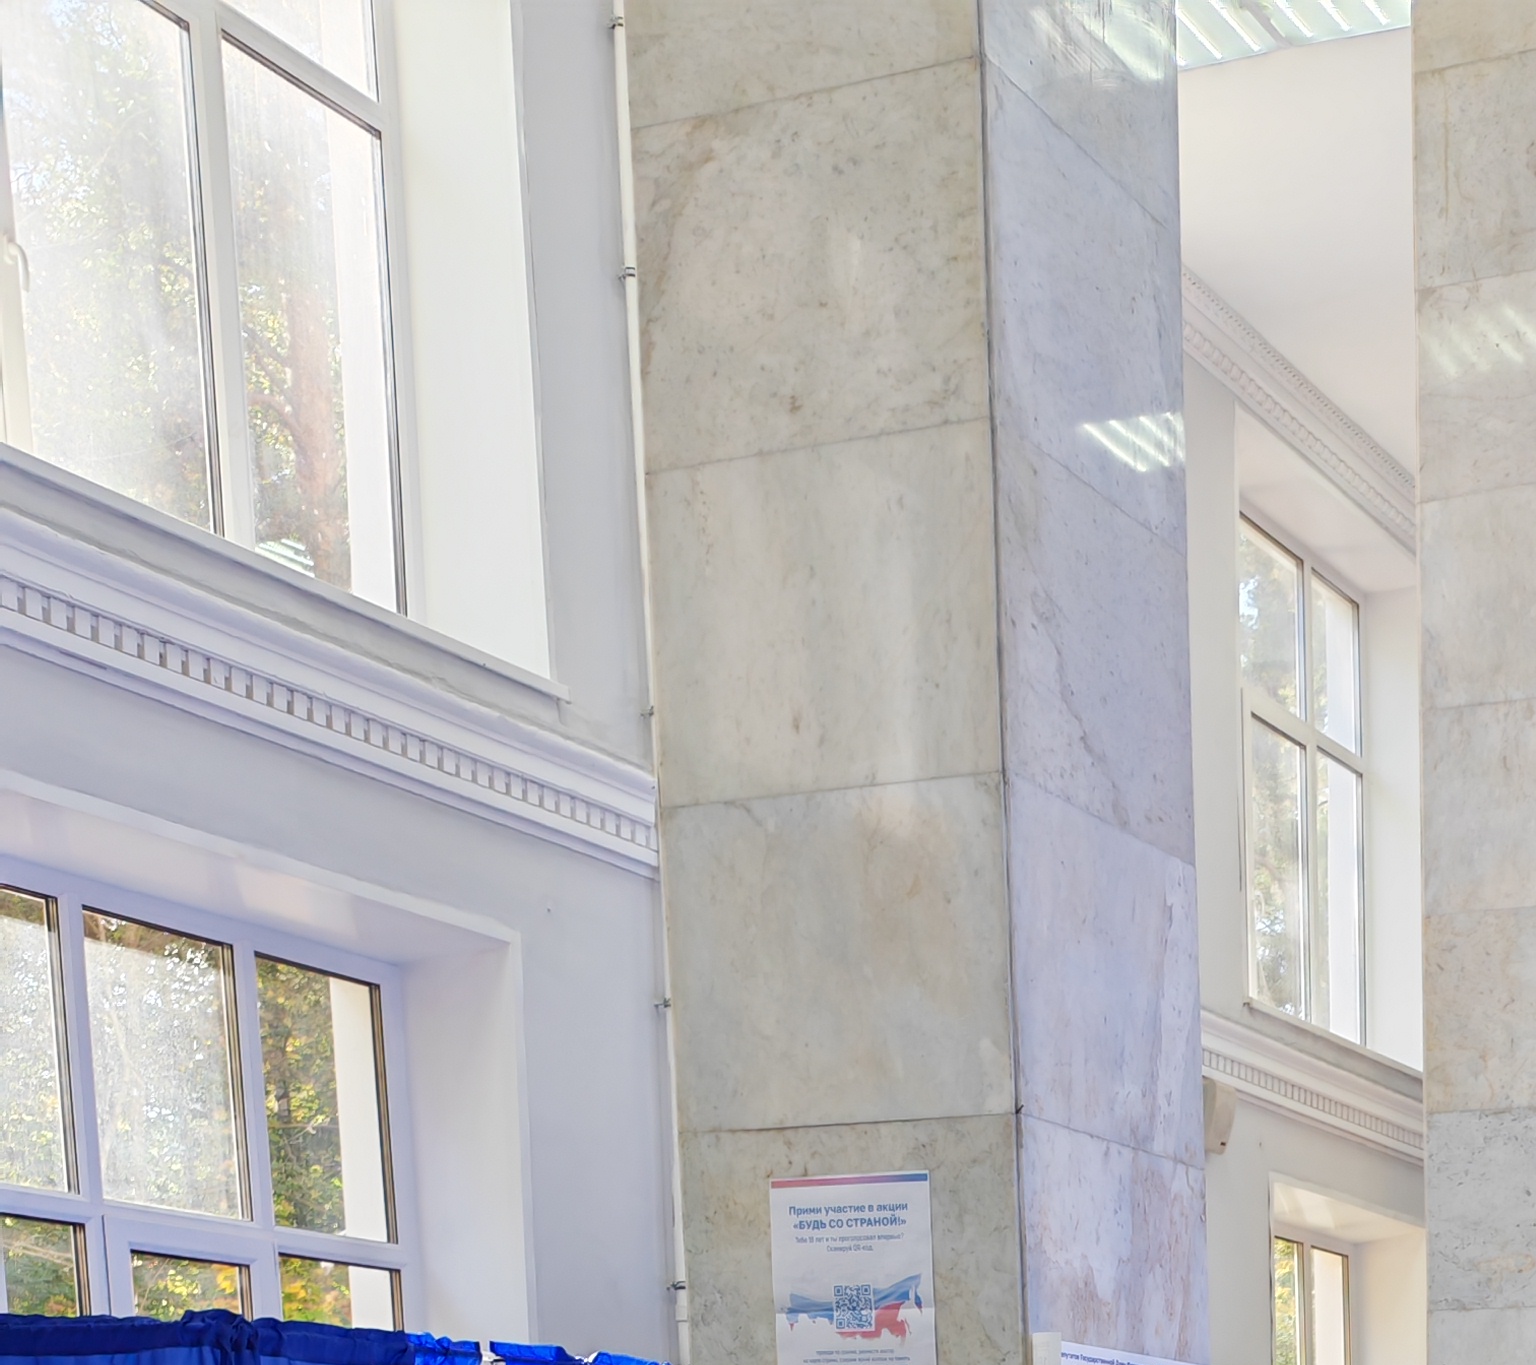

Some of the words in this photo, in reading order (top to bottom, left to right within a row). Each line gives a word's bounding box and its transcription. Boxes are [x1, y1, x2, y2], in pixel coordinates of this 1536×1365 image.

[788, 1206, 822, 1218] Прими
[824, 1204, 866, 1216] участие
[868, 1204, 874, 1212] в
[876, 1203, 908, 1213] акции
[793, 1220, 827, 1231] «БУДЬ
[828, 1218, 844, 1229] СО
[846, 1214, 907, 1228] СТРАНОЙ!»
